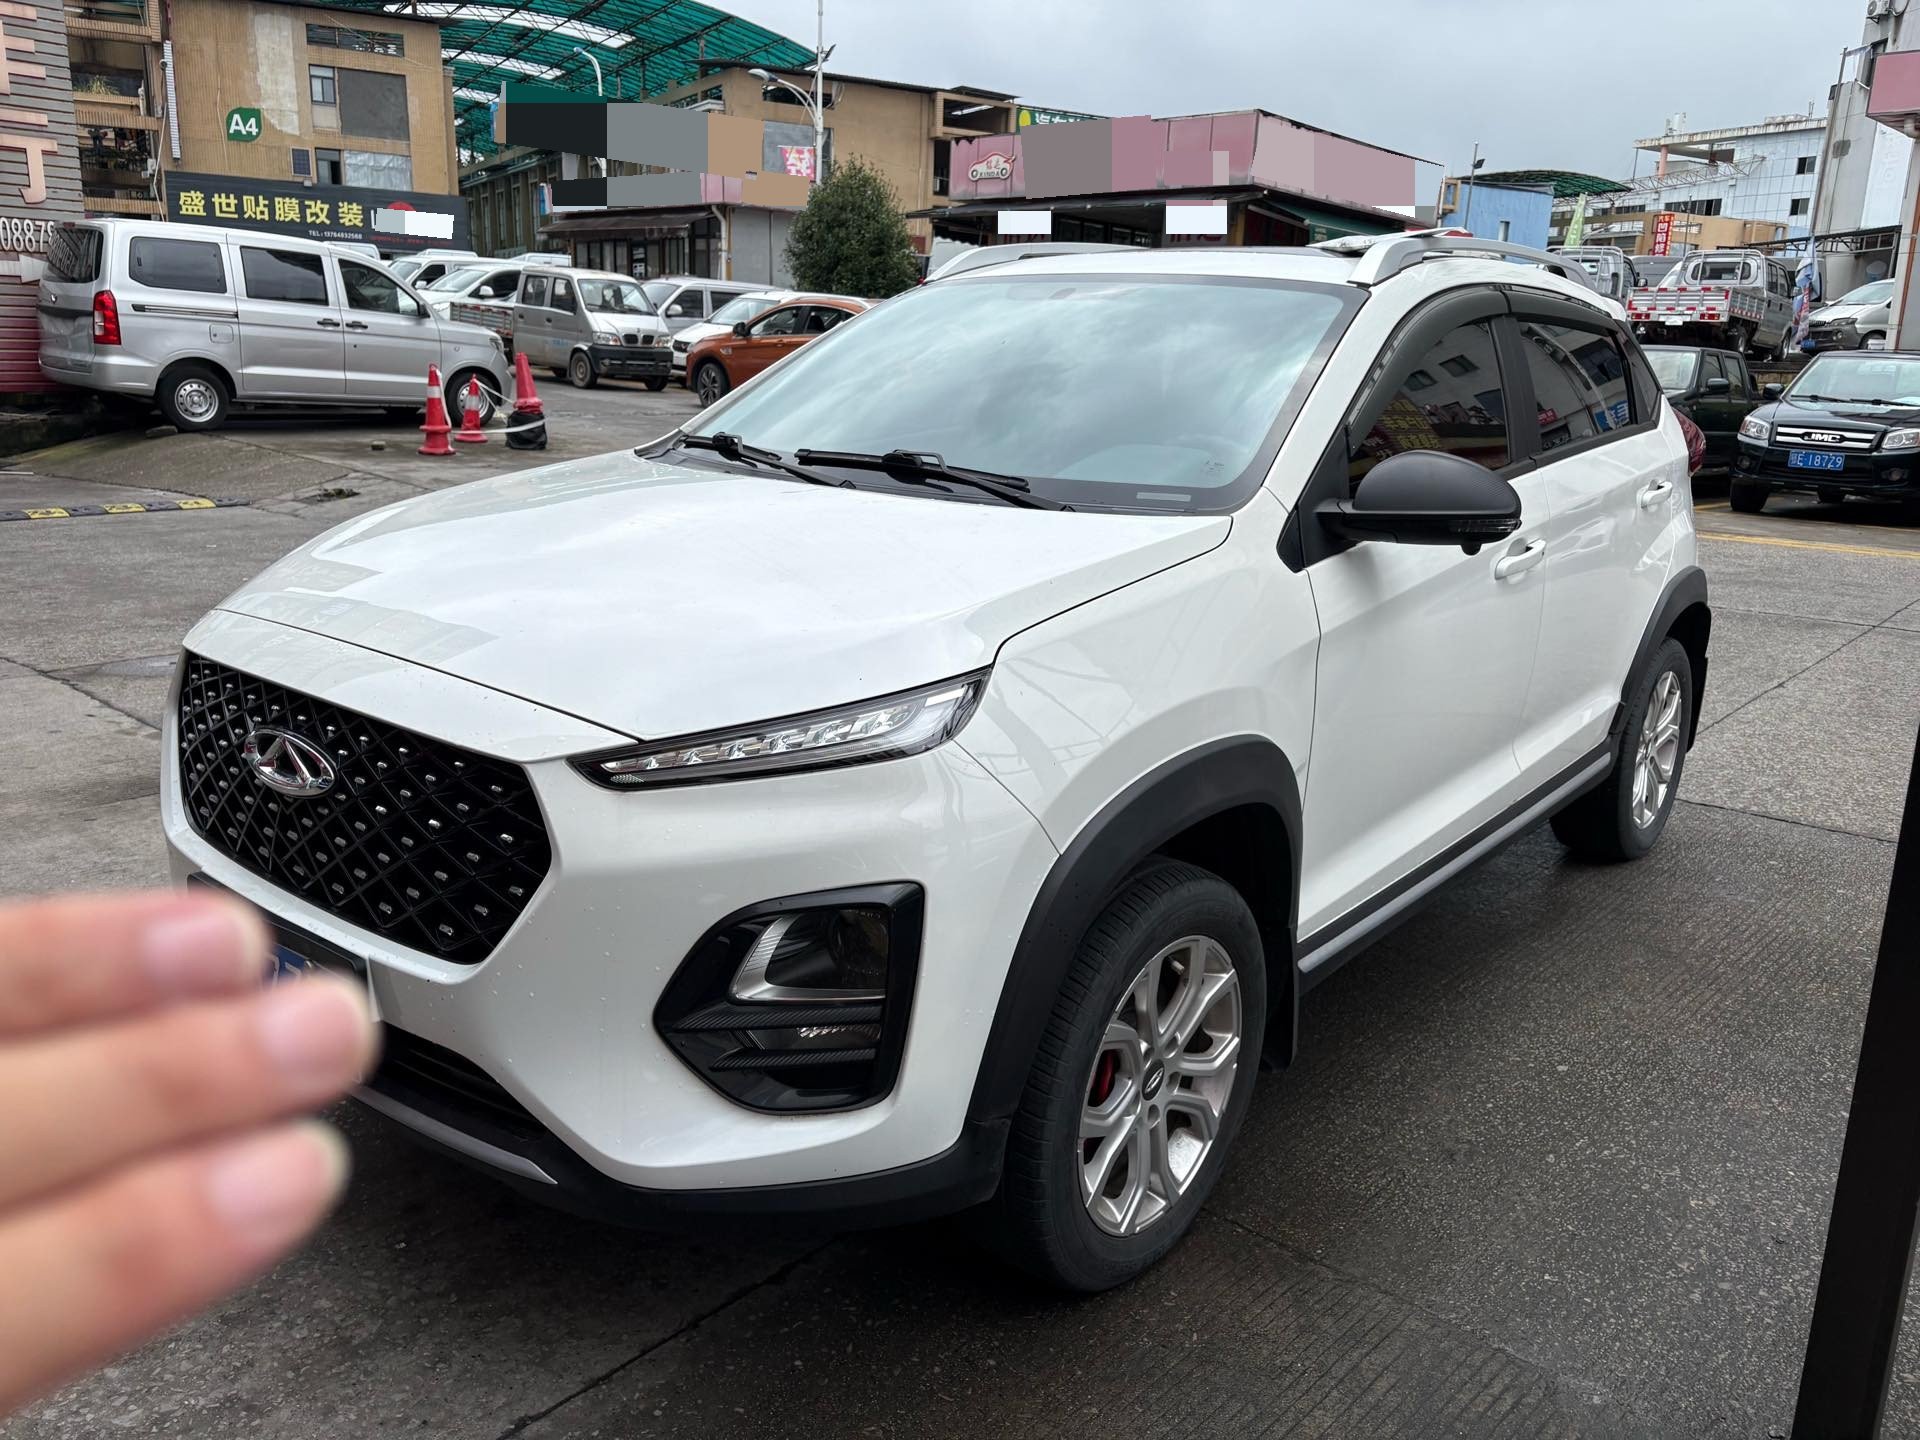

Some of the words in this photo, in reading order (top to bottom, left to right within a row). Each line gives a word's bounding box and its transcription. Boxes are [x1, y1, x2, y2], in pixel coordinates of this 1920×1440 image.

[229, 113, 259, 136] A4
[179, 190, 364, 228] 盛世贴膜改装
[1804, 433, 1841, 442] JMC
